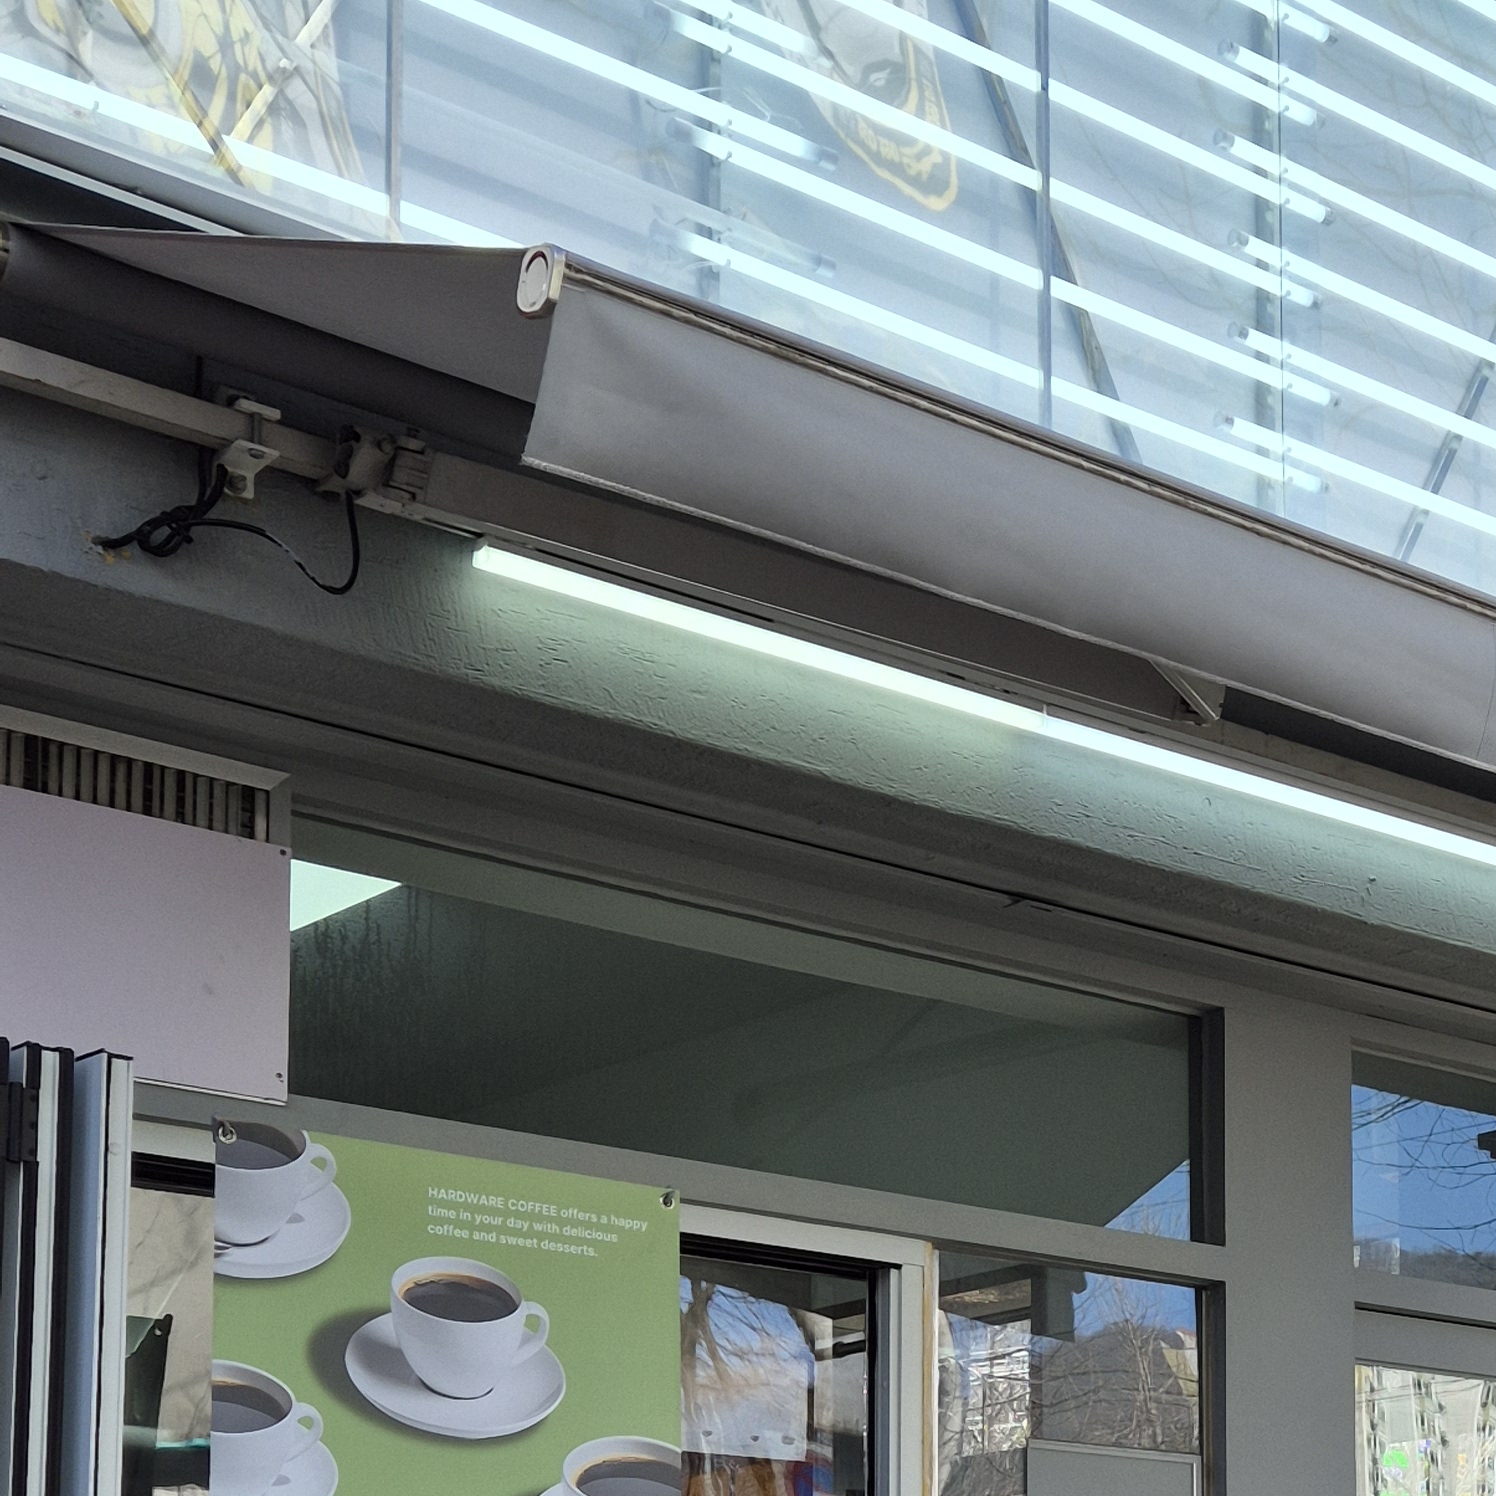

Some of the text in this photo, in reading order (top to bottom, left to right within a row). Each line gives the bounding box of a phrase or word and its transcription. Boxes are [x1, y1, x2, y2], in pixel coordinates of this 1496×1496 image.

[428, 1186, 648, 1232] HARDWARE COFFEE offers a happy
[428, 1205, 618, 1243] time in your day with delicious
[427, 1222, 599, 1257] coffee and sweet desserts.
